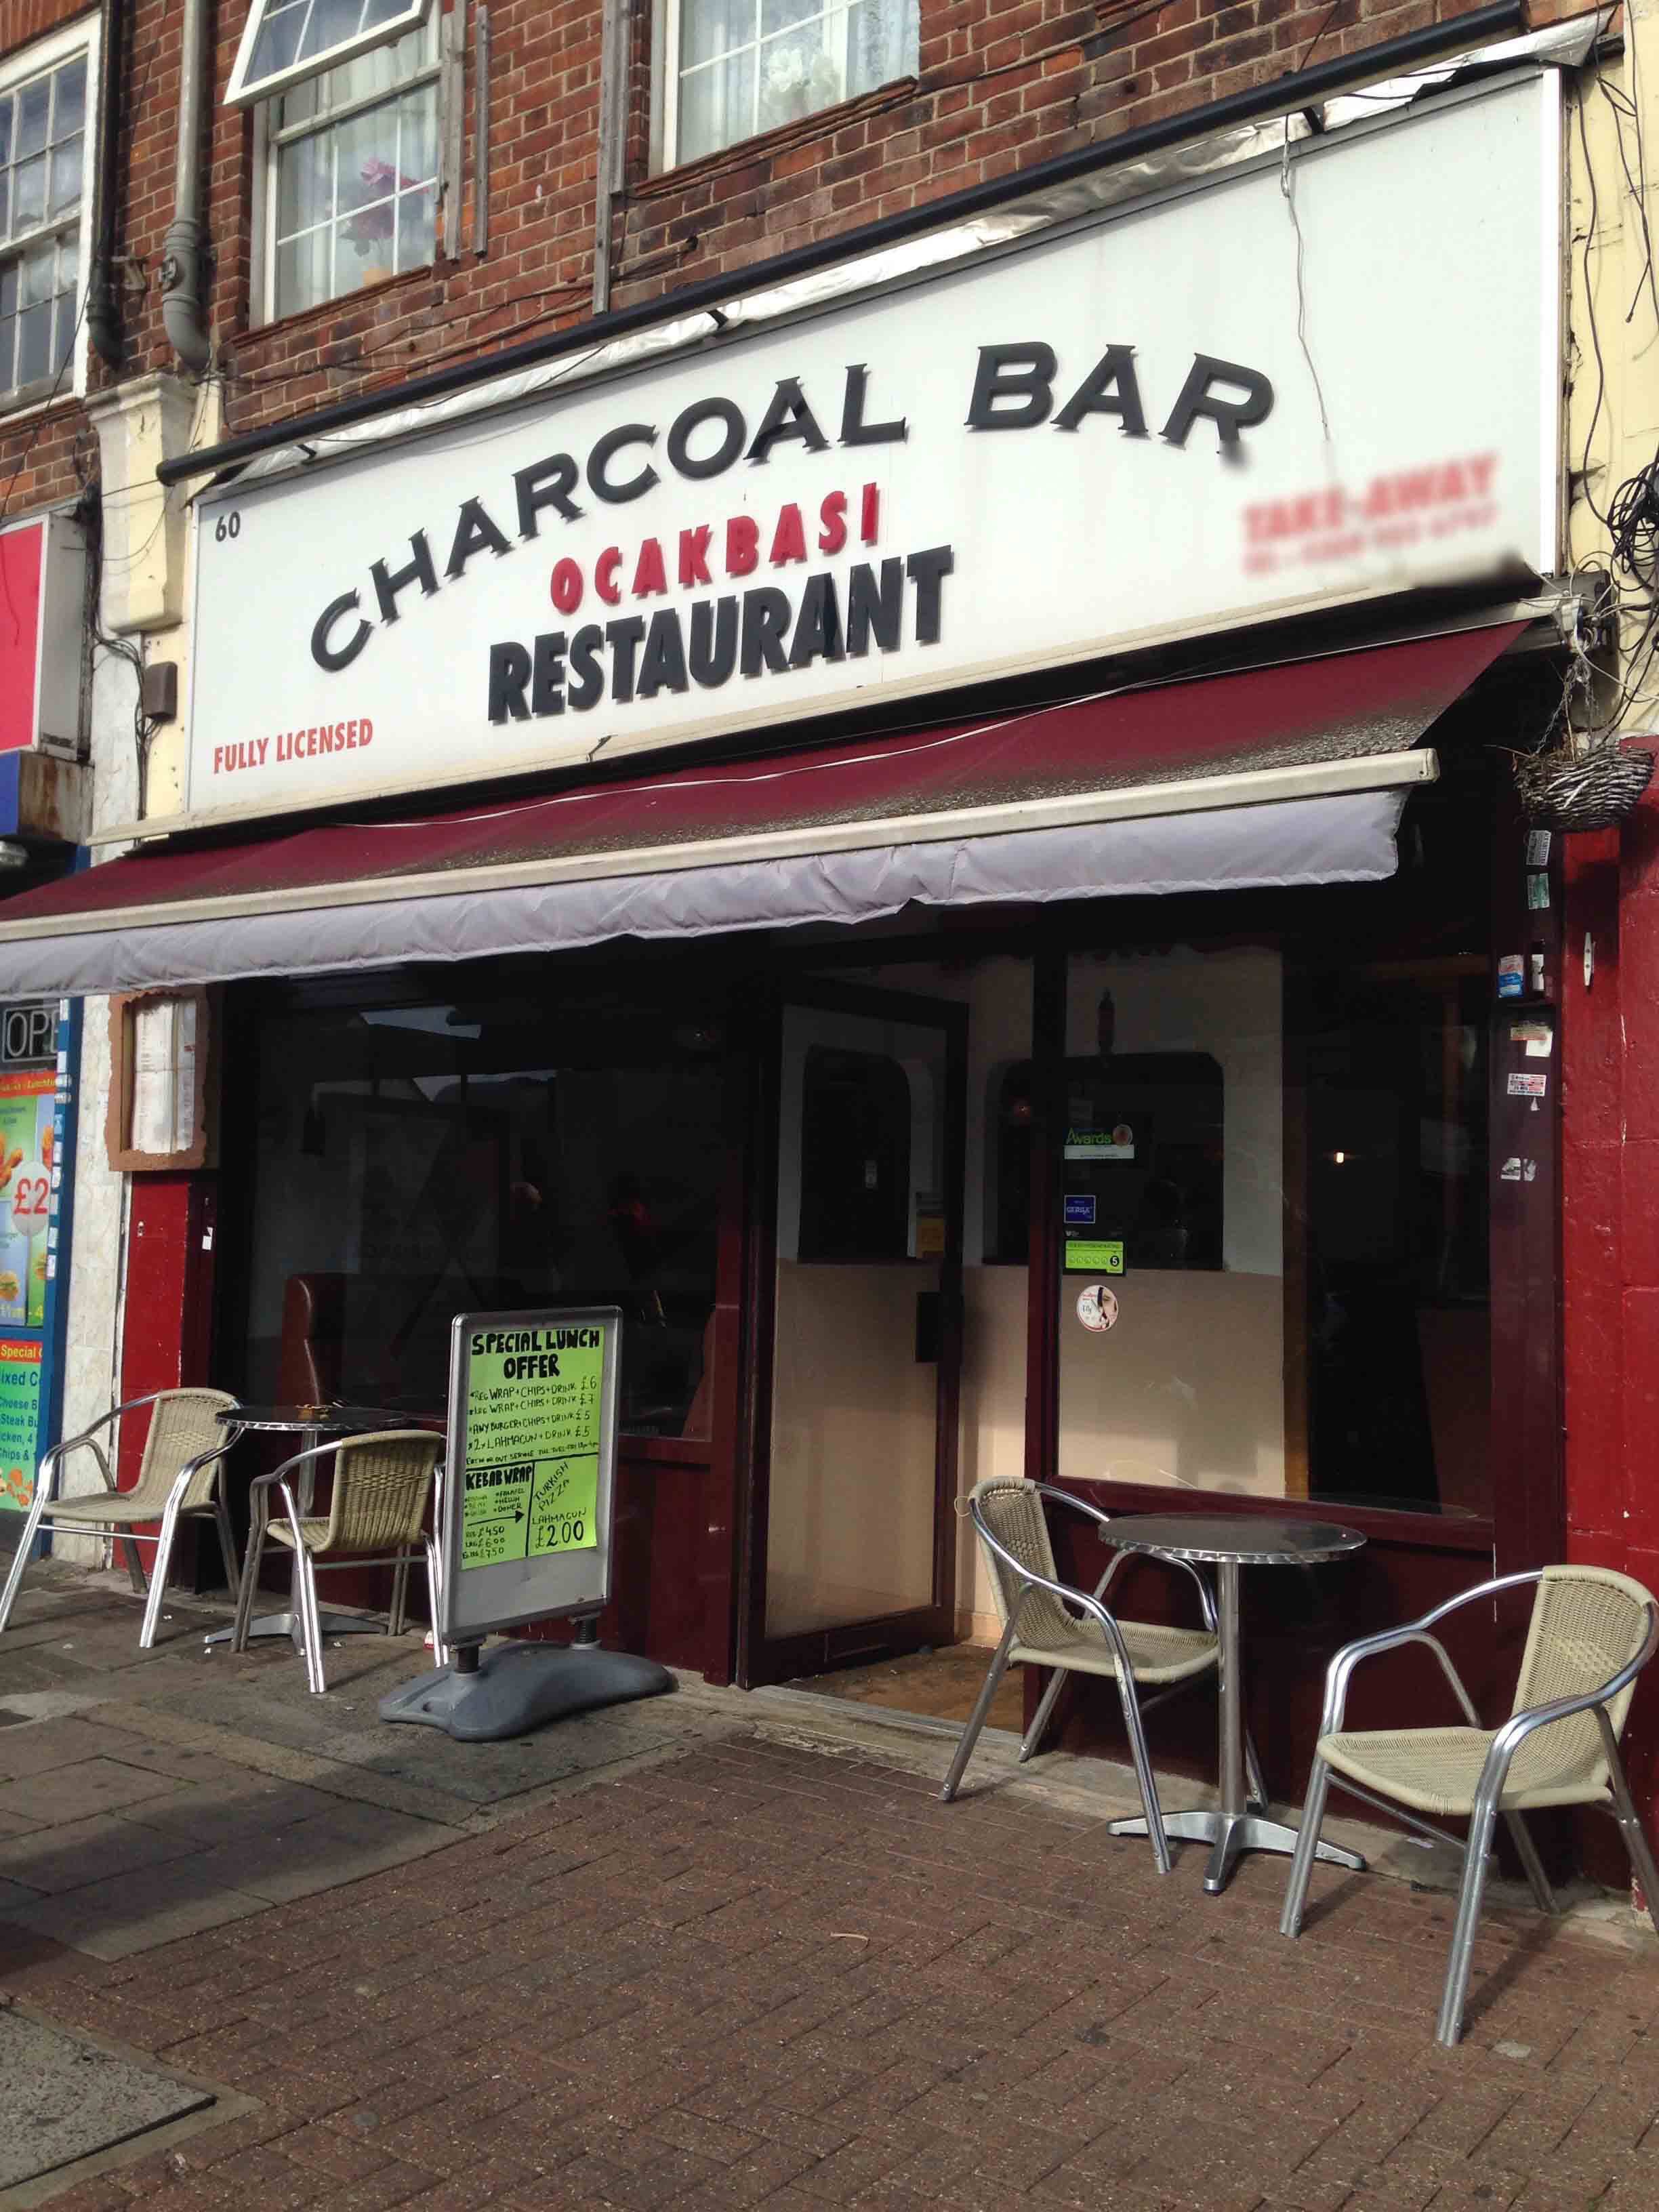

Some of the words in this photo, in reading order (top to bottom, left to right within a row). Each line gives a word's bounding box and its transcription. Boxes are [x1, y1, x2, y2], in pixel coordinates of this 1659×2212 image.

[309, 363, 907, 672] CHARCOAL
[964, 341, 1275, 464] BAR
[215, 511, 241, 542] 60
[550, 481, 879, 615] OCAKBASI
[487, 544, 952, 724] RESTAURANT
[214, 737, 269, 774] FULLY
[276, 718, 373, 762] LICENSED
[1066, 1128, 1111, 1145] Awards
[14, 1177, 49, 1215] £2
[1, 1345, 36, 1360] Special
[471, 1331, 542, 1355] SPECIAL
[546, 1328, 600, 1351] LUNCH
[504, 1353, 560, 1380] OFFER
[1, 1413, 25, 1427] Steak
[466, 1470, 502, 1490] KEBAB
[504, 1466, 533, 1485] WRAP
